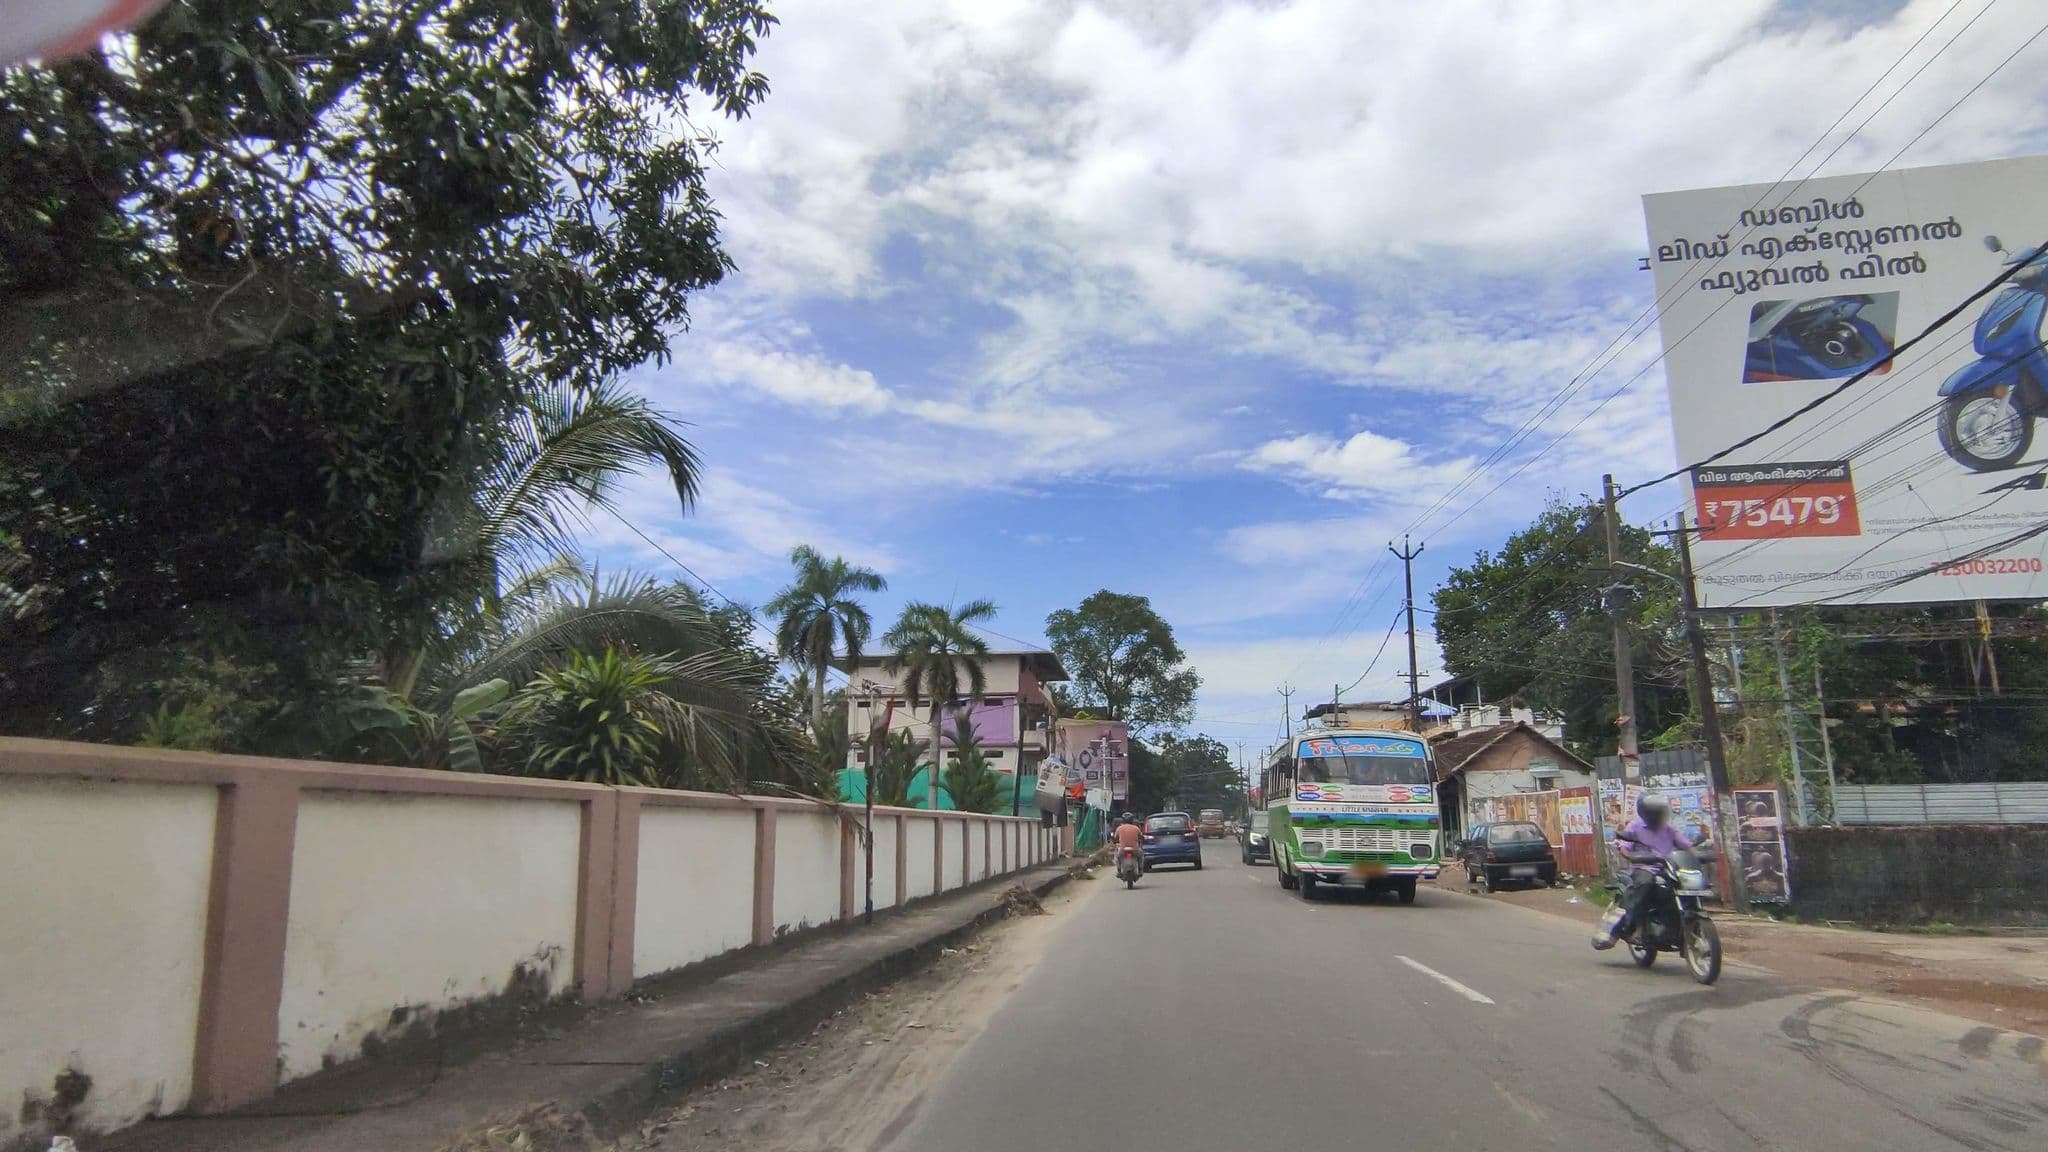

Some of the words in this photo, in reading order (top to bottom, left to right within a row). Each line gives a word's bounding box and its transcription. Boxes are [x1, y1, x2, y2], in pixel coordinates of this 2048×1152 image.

[1740, 196, 1865, 227] ഡബിൾ
[1657, 233, 1730, 263] ലിഡ്
[1700, 260, 1830, 295] ഫ്യുവൽ
[1839, 250, 1927, 281] ഫിൽ
[1698, 471, 1727, 483] വില
